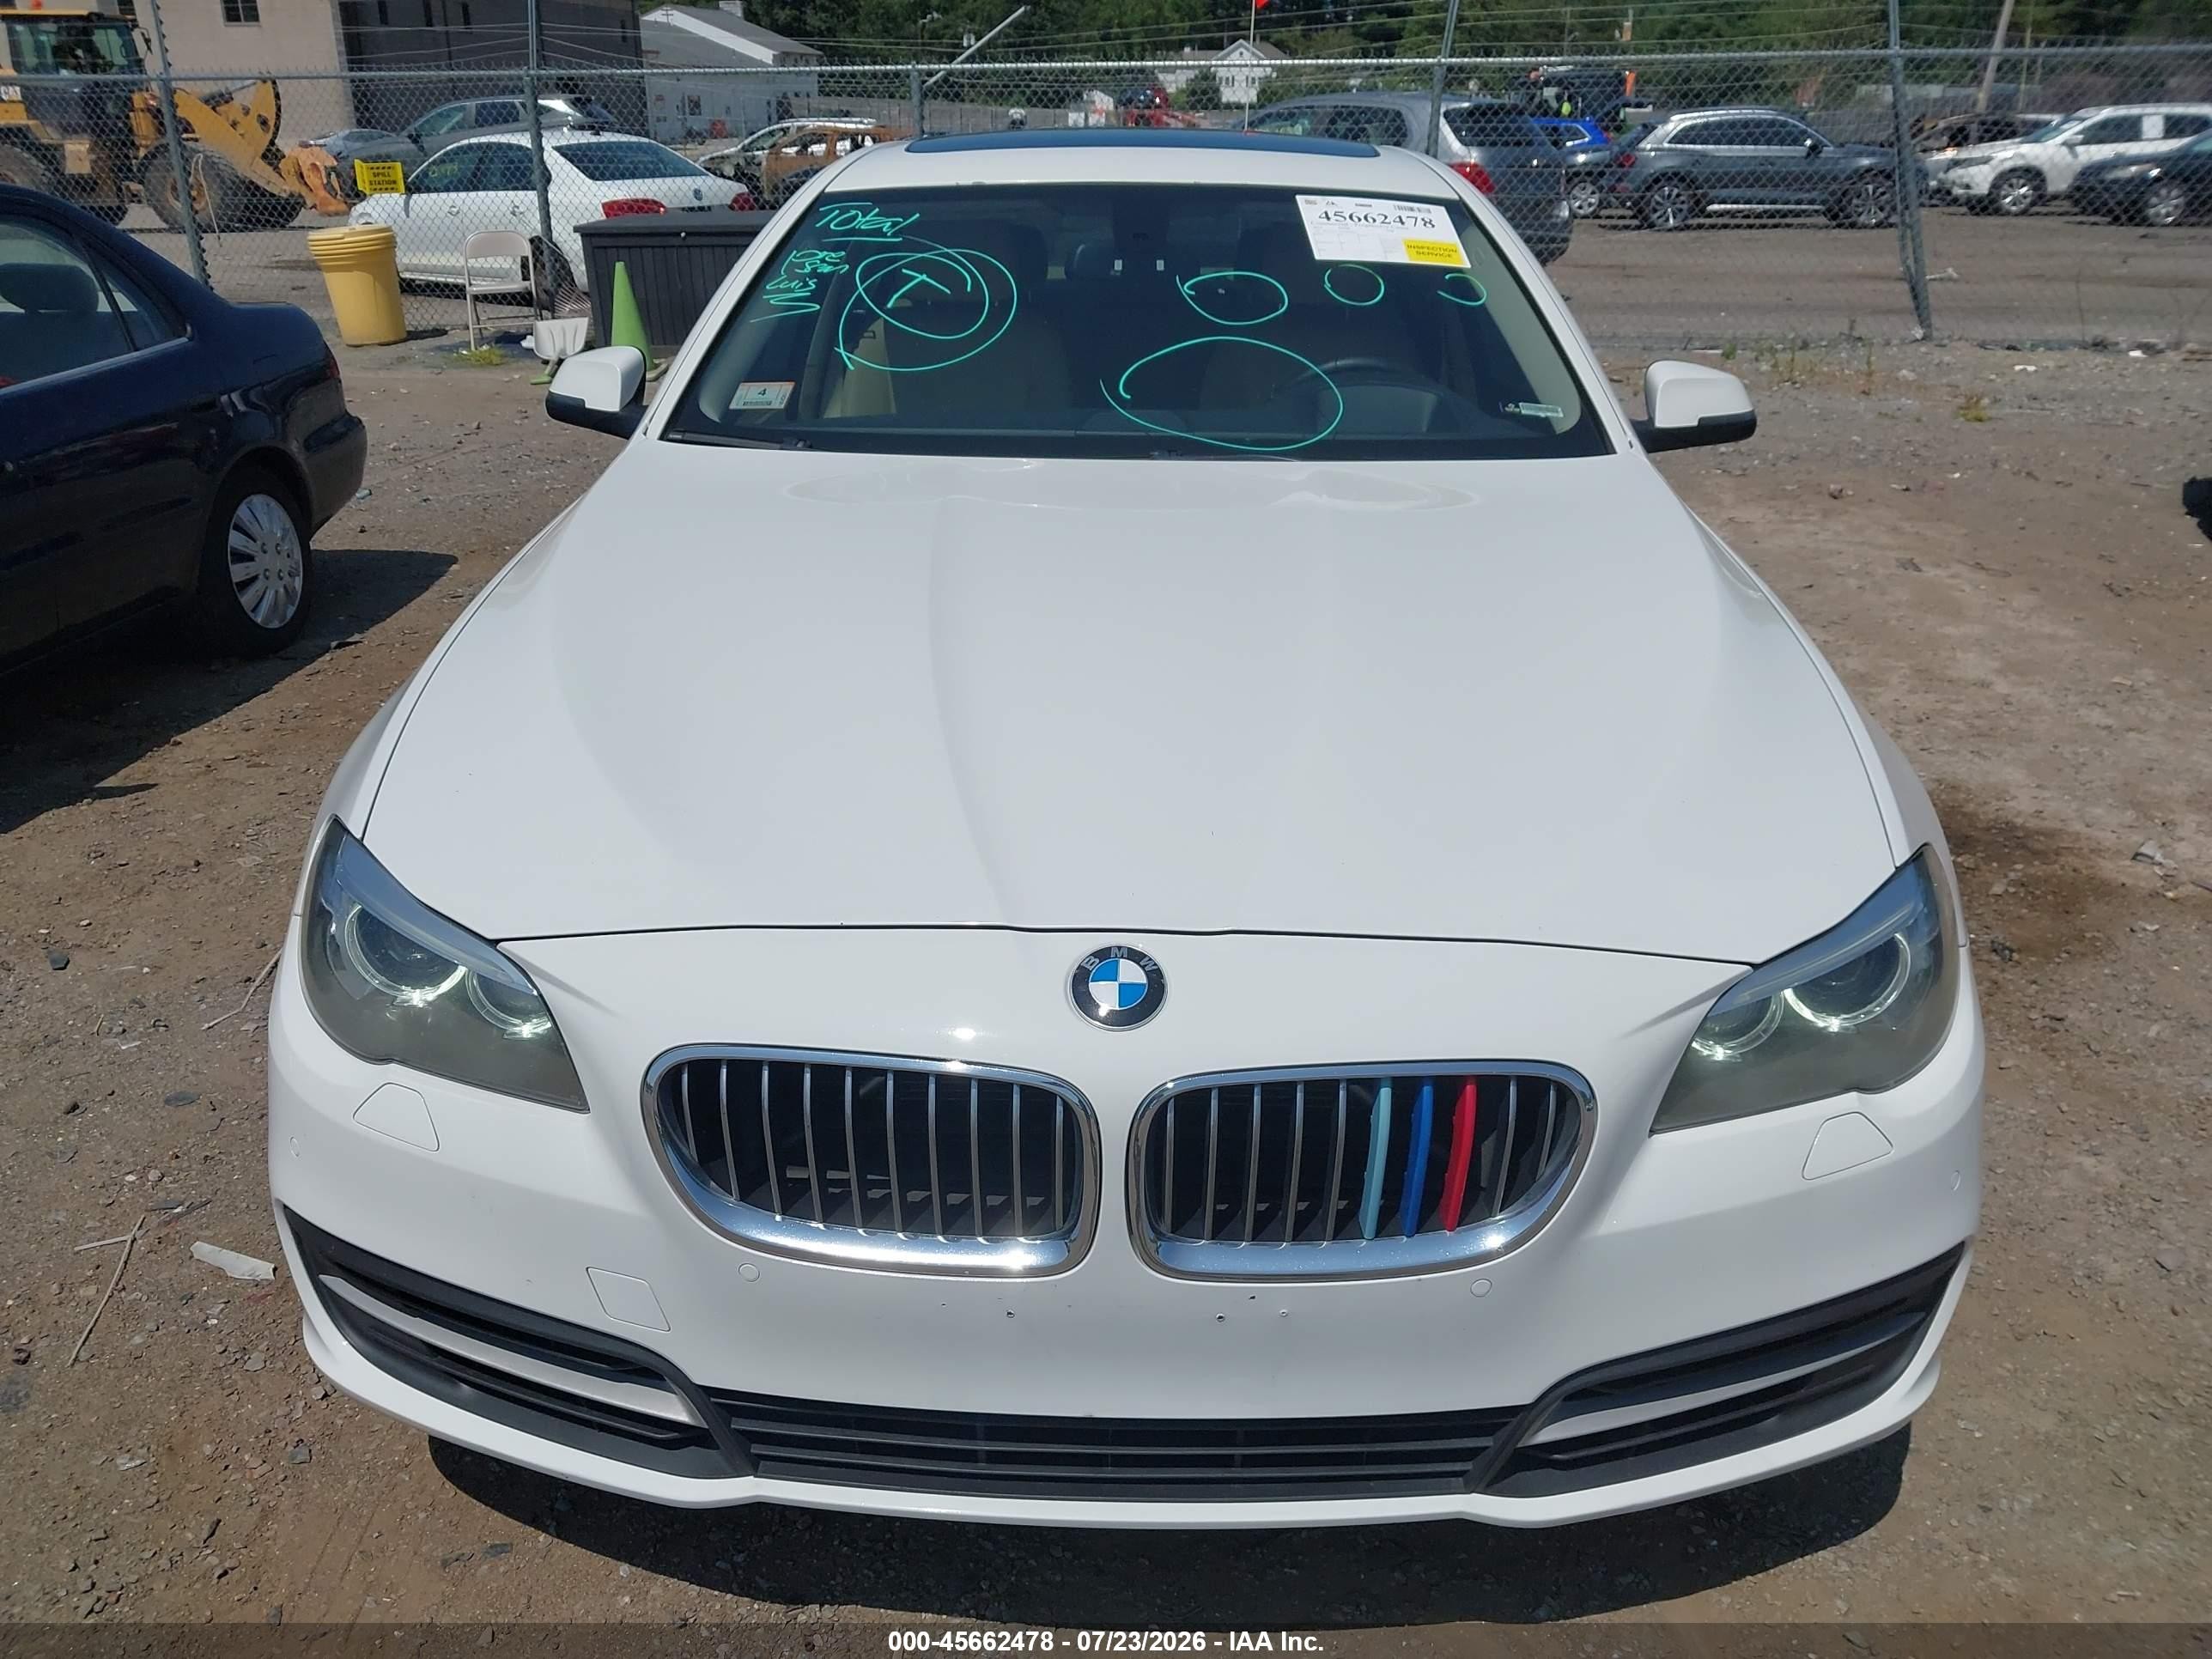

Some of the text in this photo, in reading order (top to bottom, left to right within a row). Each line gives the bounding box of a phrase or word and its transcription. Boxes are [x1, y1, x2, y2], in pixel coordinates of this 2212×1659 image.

[1318, 210, 1437, 229] 45662478
[1407, 244, 1458, 253] INSPECTION
[757, 387, 768, 397] 4
[1080, 946, 1159, 971] BMW
